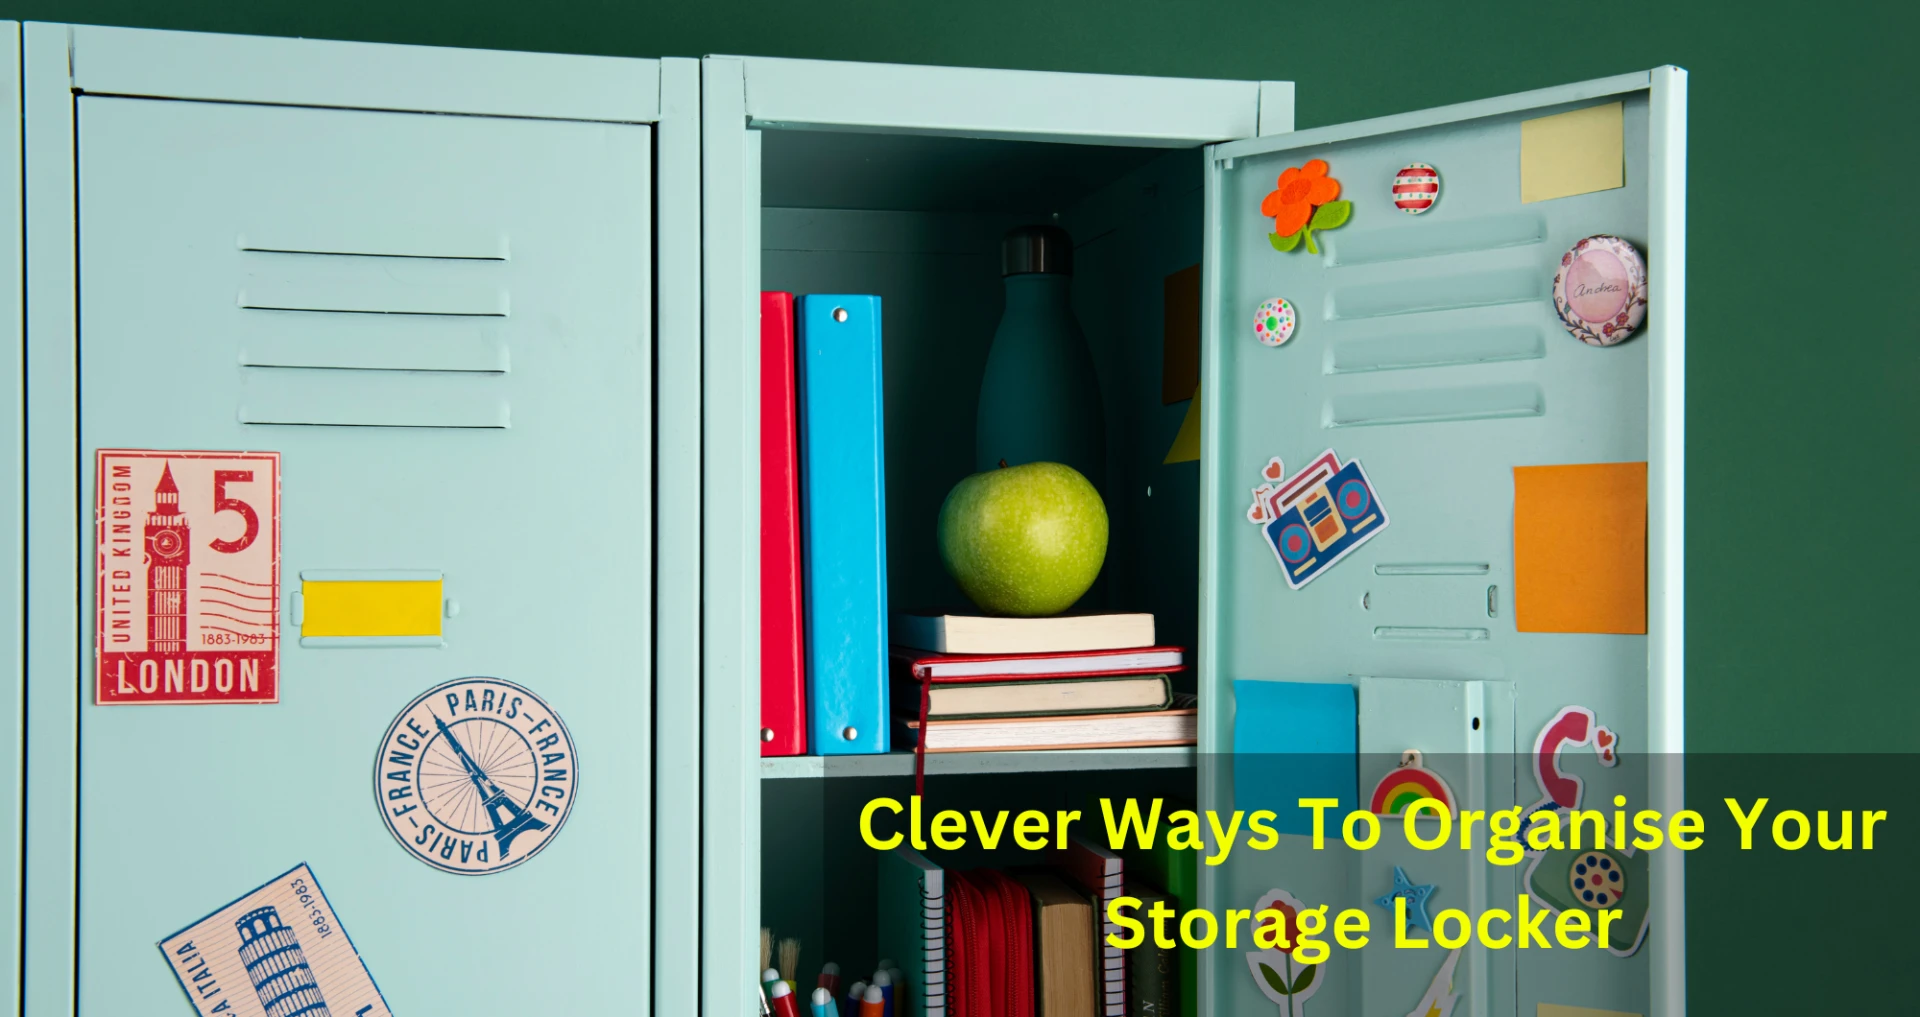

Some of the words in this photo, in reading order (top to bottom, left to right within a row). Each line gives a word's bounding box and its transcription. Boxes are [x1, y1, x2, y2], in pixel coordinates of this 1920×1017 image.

[1573, 282, 1622, 298] Andrea
[112, 465, 131, 557] KINGDOM
[209, 470, 259, 554] 5
[112, 570, 131, 643] UNITED
[201, 632, 265, 646] 1883-1983
[117, 658, 259, 694] LONDON
[290, 878, 332, 939] 1883-1983
[176, 940, 222, 1000] ITALIA
